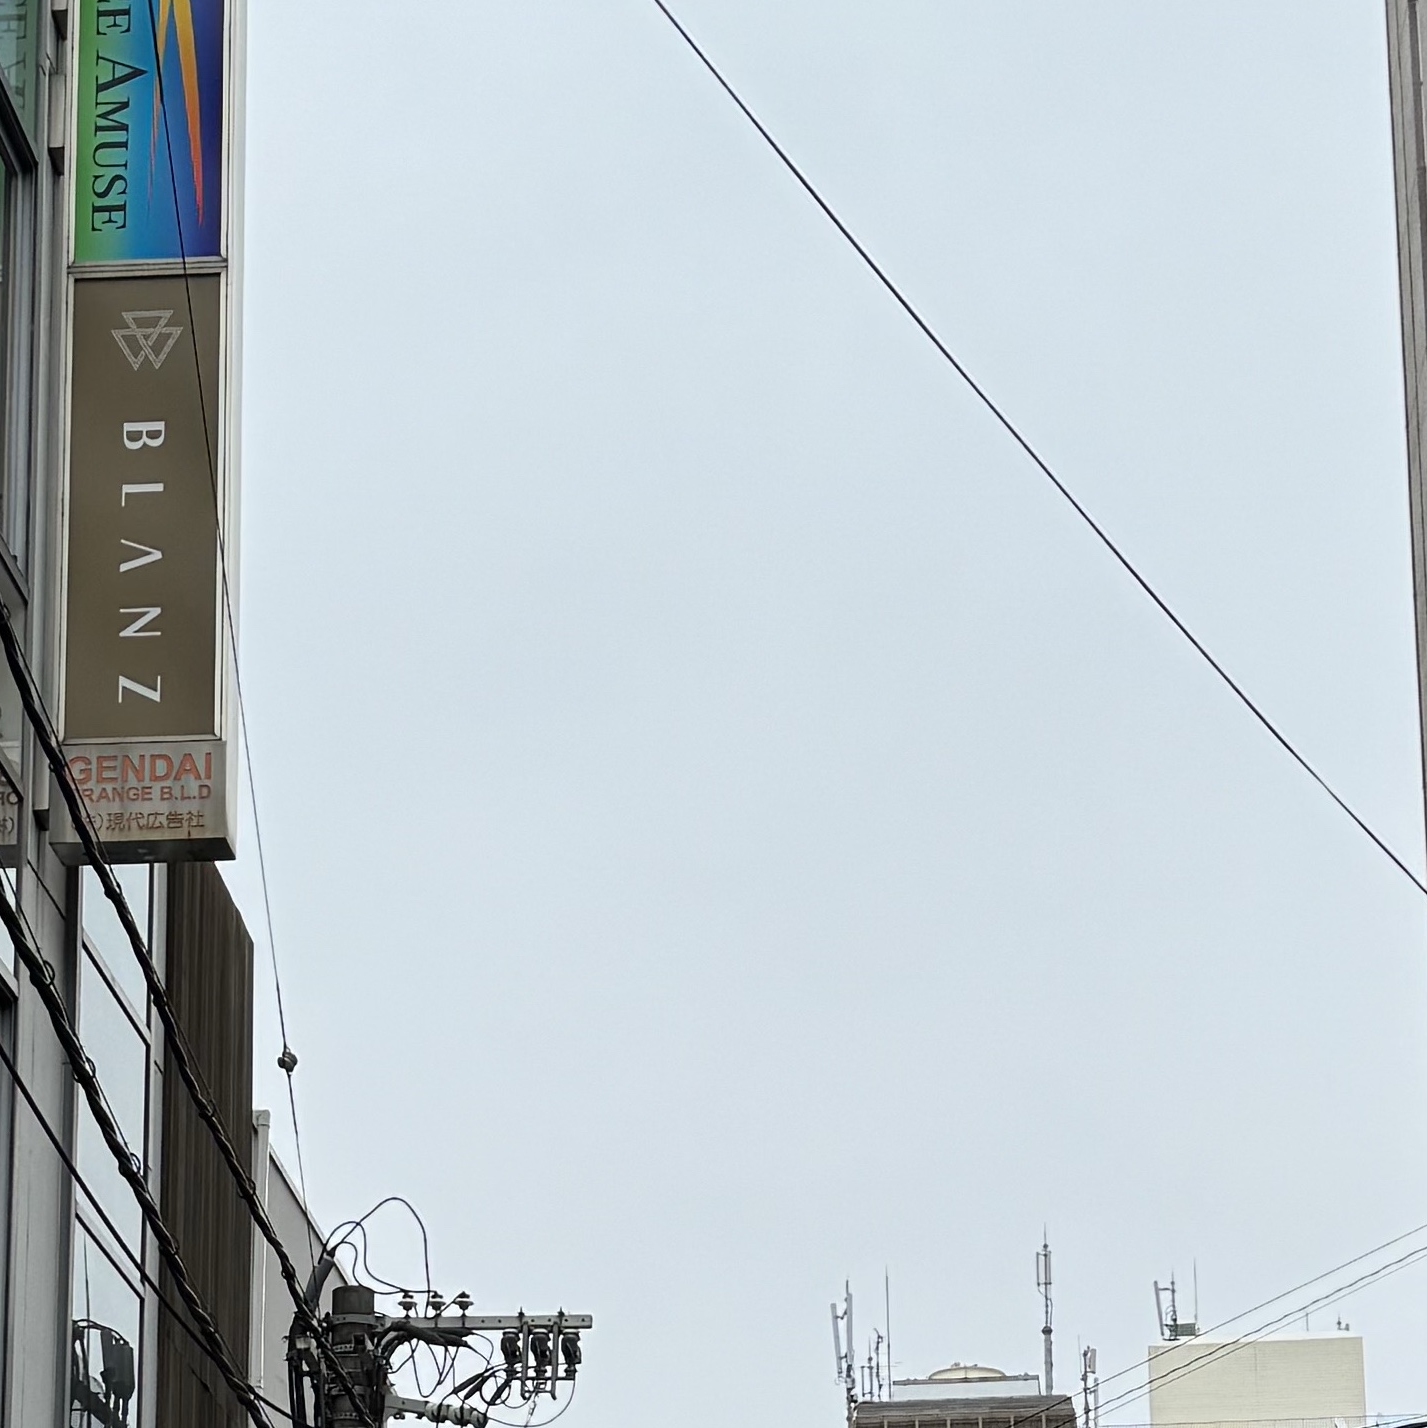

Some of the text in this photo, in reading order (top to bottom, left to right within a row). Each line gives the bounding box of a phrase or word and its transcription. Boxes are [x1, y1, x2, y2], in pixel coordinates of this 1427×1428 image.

[91, 0, 148, 232] E AMUSE
[68, 752, 213, 786] GENDAI
[74, 783, 152, 803] RANGE
